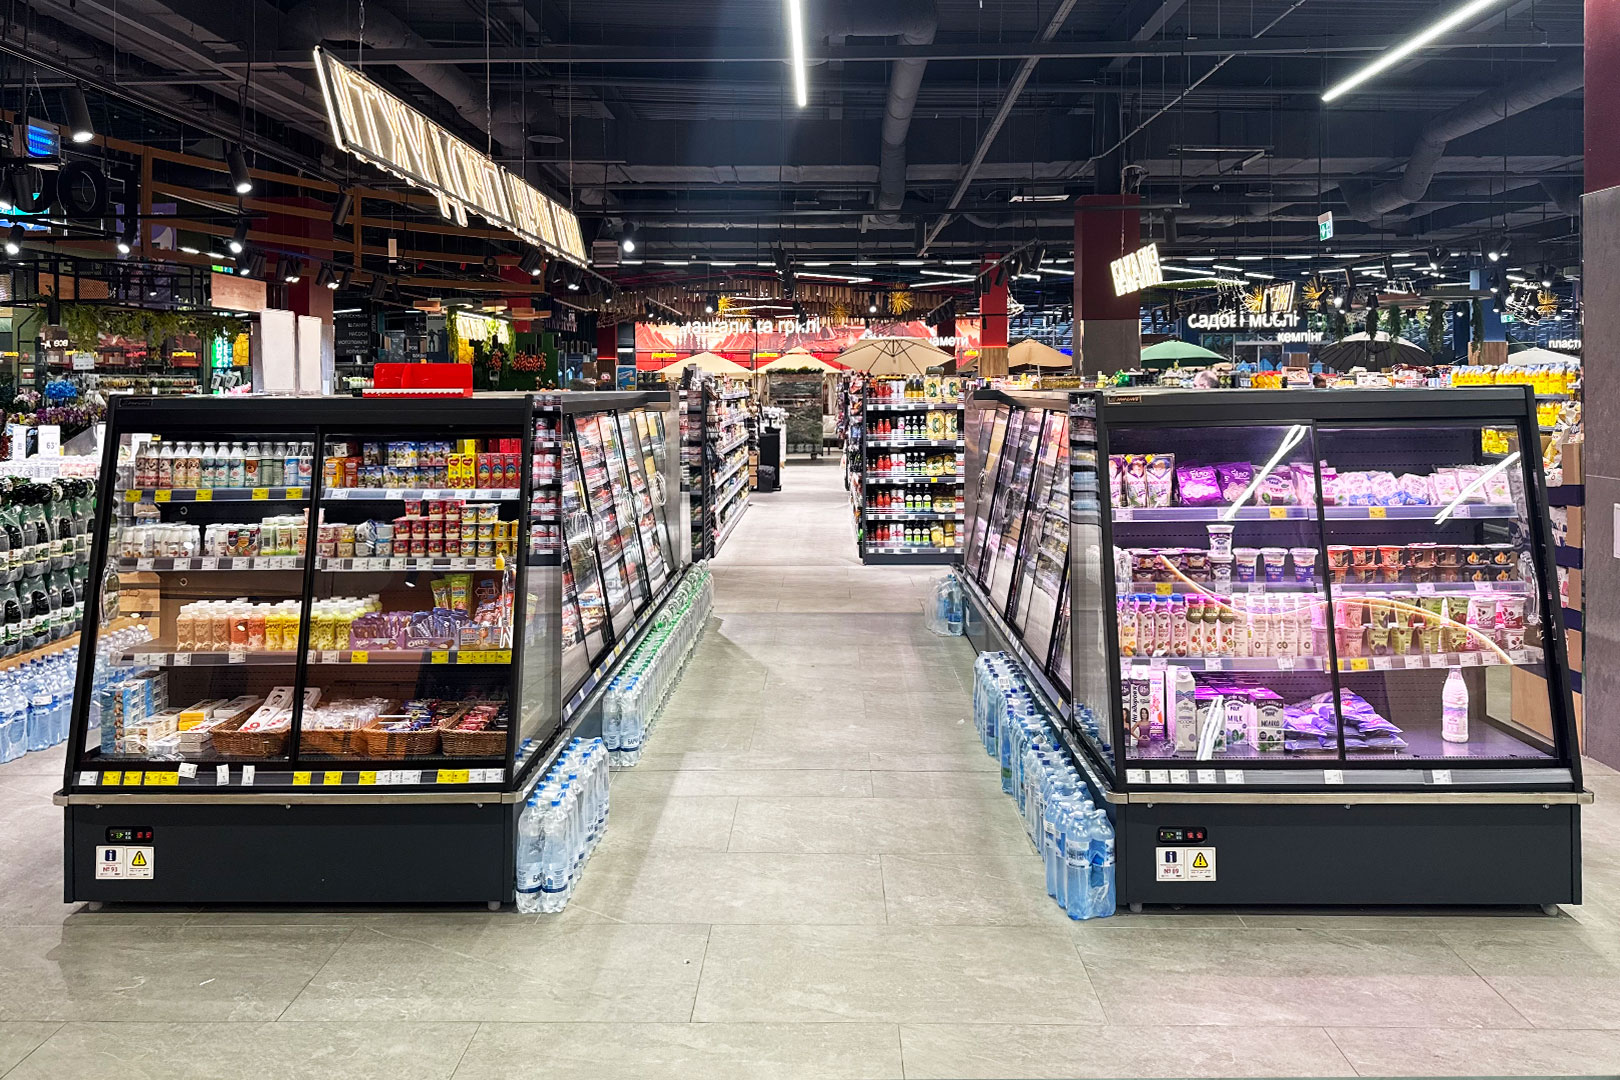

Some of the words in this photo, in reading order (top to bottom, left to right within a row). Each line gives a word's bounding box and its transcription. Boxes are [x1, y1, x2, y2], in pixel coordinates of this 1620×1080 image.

[679, 320, 750, 334] мангали
[756, 320, 773, 334] та
[1277, 330, 1324, 343] кемпінг
